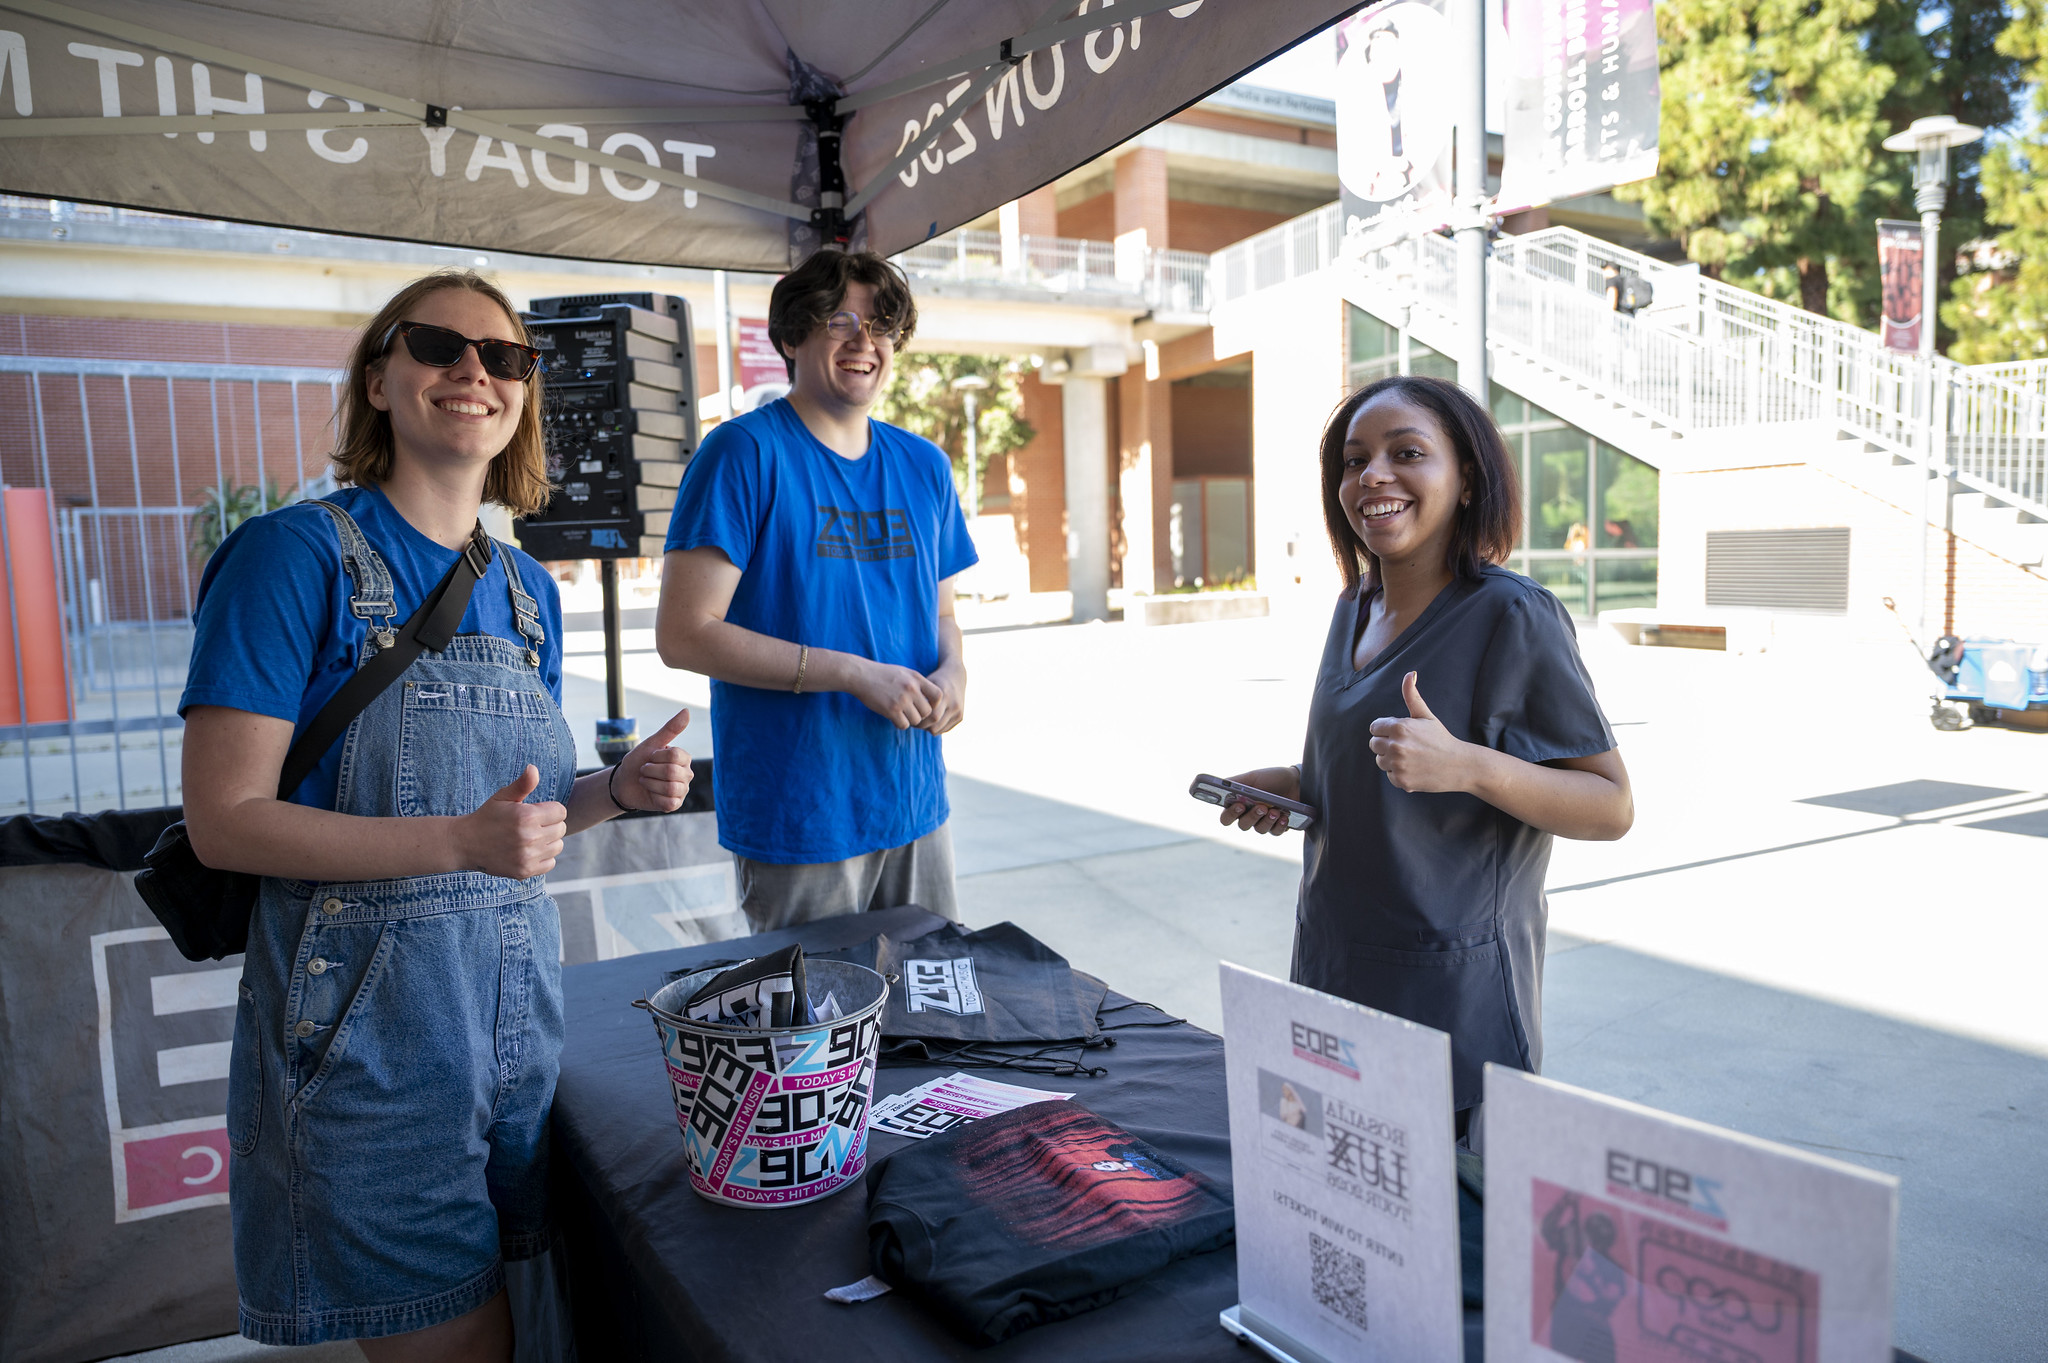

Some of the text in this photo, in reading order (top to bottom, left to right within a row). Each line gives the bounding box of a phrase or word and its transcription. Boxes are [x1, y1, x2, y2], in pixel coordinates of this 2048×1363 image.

[1602, 81, 1619, 101] &
[1600, 111, 1619, 162] RTS
[794, 1069, 846, 1088] TODAY'S
[928, 1100, 960, 1112] MUSIC
[712, 1080, 765, 1180] TODAY'S HIT MUSIC
[785, 1135, 807, 1147] HIT
[729, 1187, 784, 1201] TODAY'S
[789, 1187, 811, 1200] HIT
